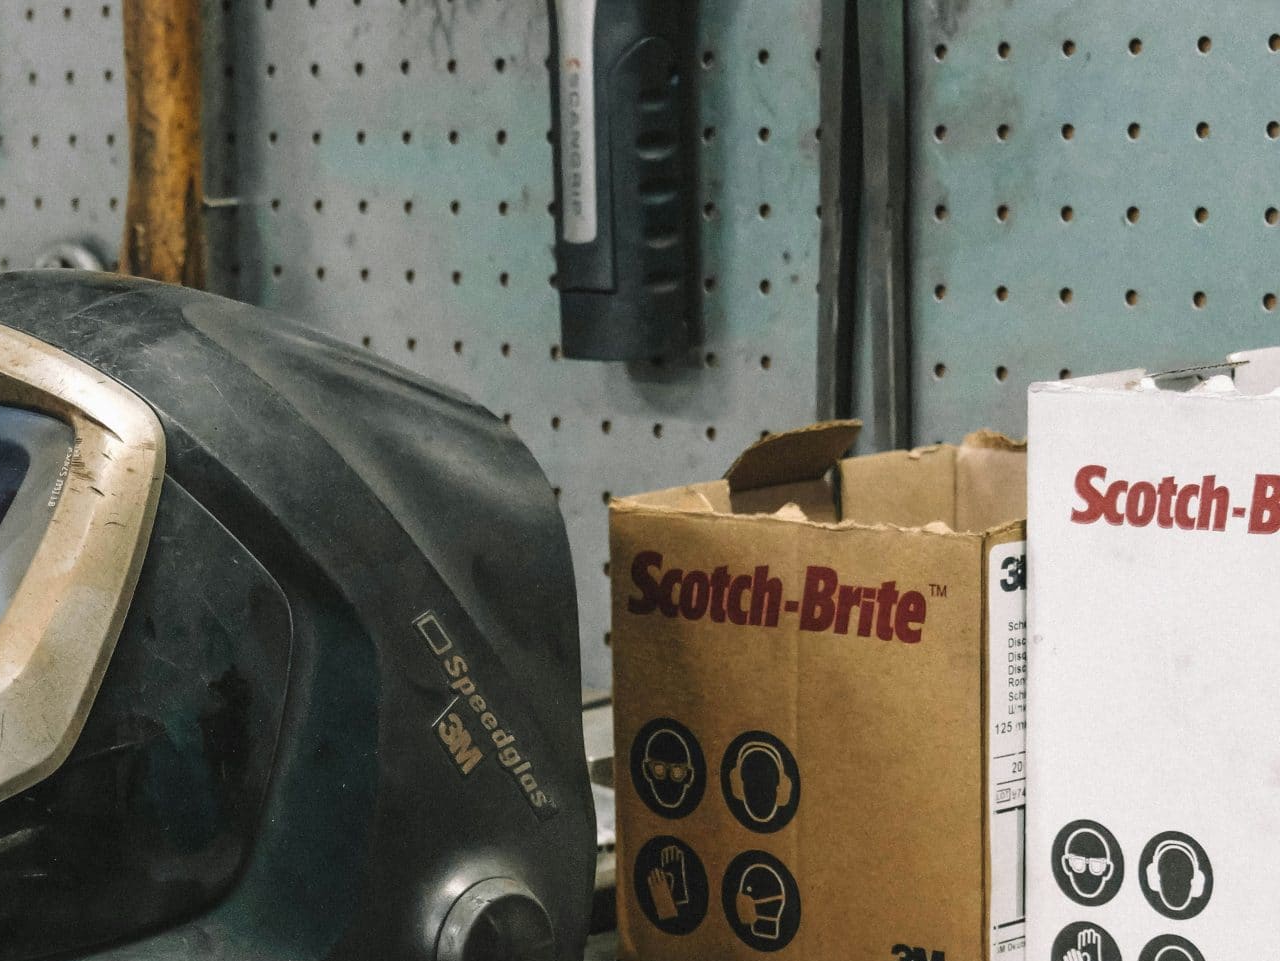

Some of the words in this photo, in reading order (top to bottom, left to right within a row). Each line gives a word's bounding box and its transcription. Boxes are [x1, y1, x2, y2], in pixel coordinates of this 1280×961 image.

[1070, 464, 1280, 535] Scotch-B
[627, 550, 927, 644] Scotch-Brite
[438, 712, 484, 775] 3M
[444, 655, 546, 808] Speedglas
[995, 721, 1013, 735] 125
